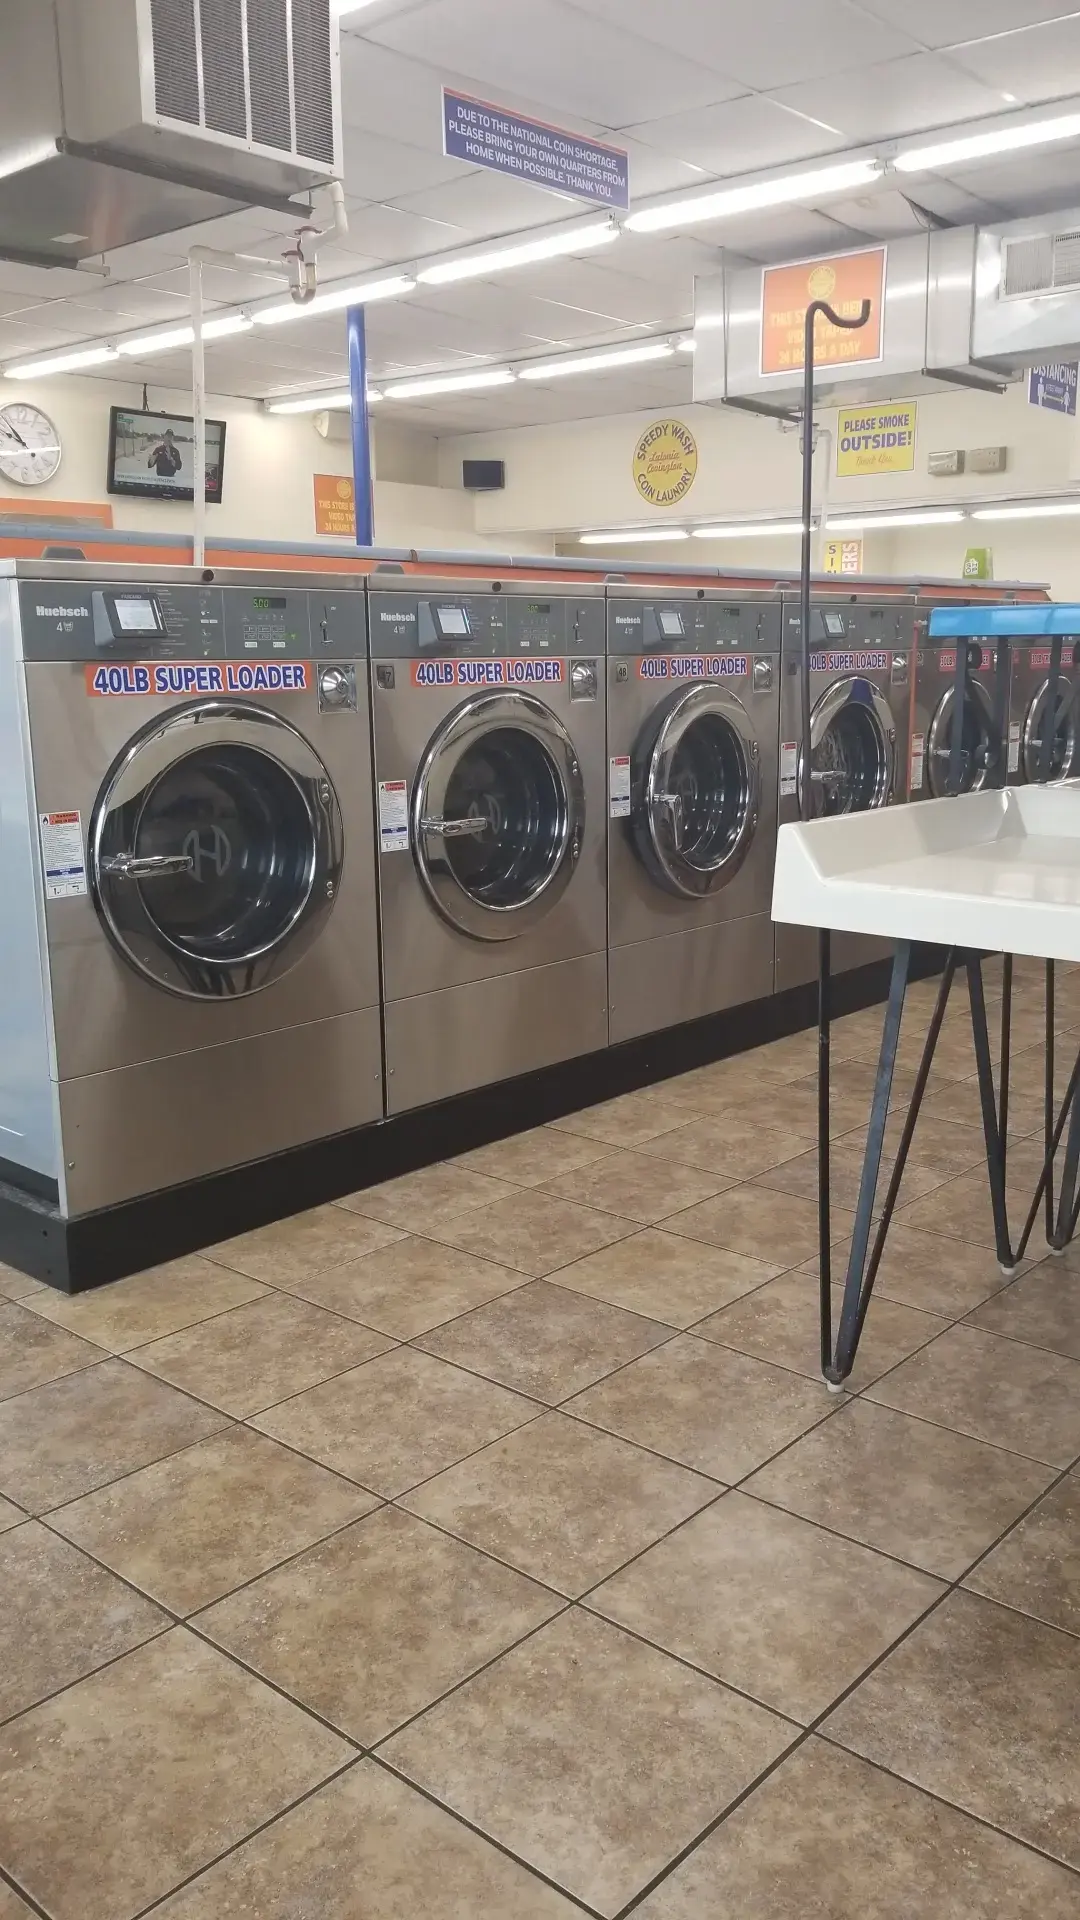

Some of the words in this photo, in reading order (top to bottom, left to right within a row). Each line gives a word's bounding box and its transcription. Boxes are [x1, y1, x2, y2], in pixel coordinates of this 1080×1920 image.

[457, 106, 477, 123] DUE
[477, 113, 490, 127] TO
[490, 118, 510, 134] THE
[510, 125, 553, 149] NATIONAL
[553, 140, 574, 157] COIN
[575, 147, 618, 172] SHORTAGE,
[448, 119, 484, 142] PLEASE
[485, 131, 513, 151] BRING
[514, 141, 538, 159] YOUR
[538, 150, 559, 166] OWN
[560, 157, 602, 180] QUARTERS
[602, 170, 626, 187] FROM
[465, 141, 494, 161] HOME
[495, 150, 522, 170] WHEN
[566, 174, 595, 193] THANK
[594, 182, 613, 198] YOU.
[793, 345, 827, 363] HORS
[844, 417, 876, 432] PLEASE
[878, 413, 910, 429] SMOKE
[637, 423, 669, 461] SPEEDY
[671, 424, 694, 456] WASH
[840, 431, 912, 453] OUTSIDE!
[637, 473, 656, 499] COIN
[656, 467, 692, 502] LAUNDRY
[842, 543, 858, 574] ERS
[36, 605, 89, 617] Huebsch
[380, 612, 416, 622] Huebsch
[615, 616, 641, 624] Huebsch
[416, 662, 454, 686] 40LB
[457, 661, 503, 684] SUPER
[507, 660, 562, 682] LOADER
[640, 658, 668, 679] 40LB
[670, 658, 704, 677] SUPER
[706, 656, 747, 676] LOADER
[808, 654, 827, 671] 0LB
[829, 653, 855, 671] SUPER
[856, 652, 888, 669] LOADER
[94, 667, 149, 694] 40LB
[155, 666, 222, 692] SUPER
[228, 664, 306, 690] LOADER
